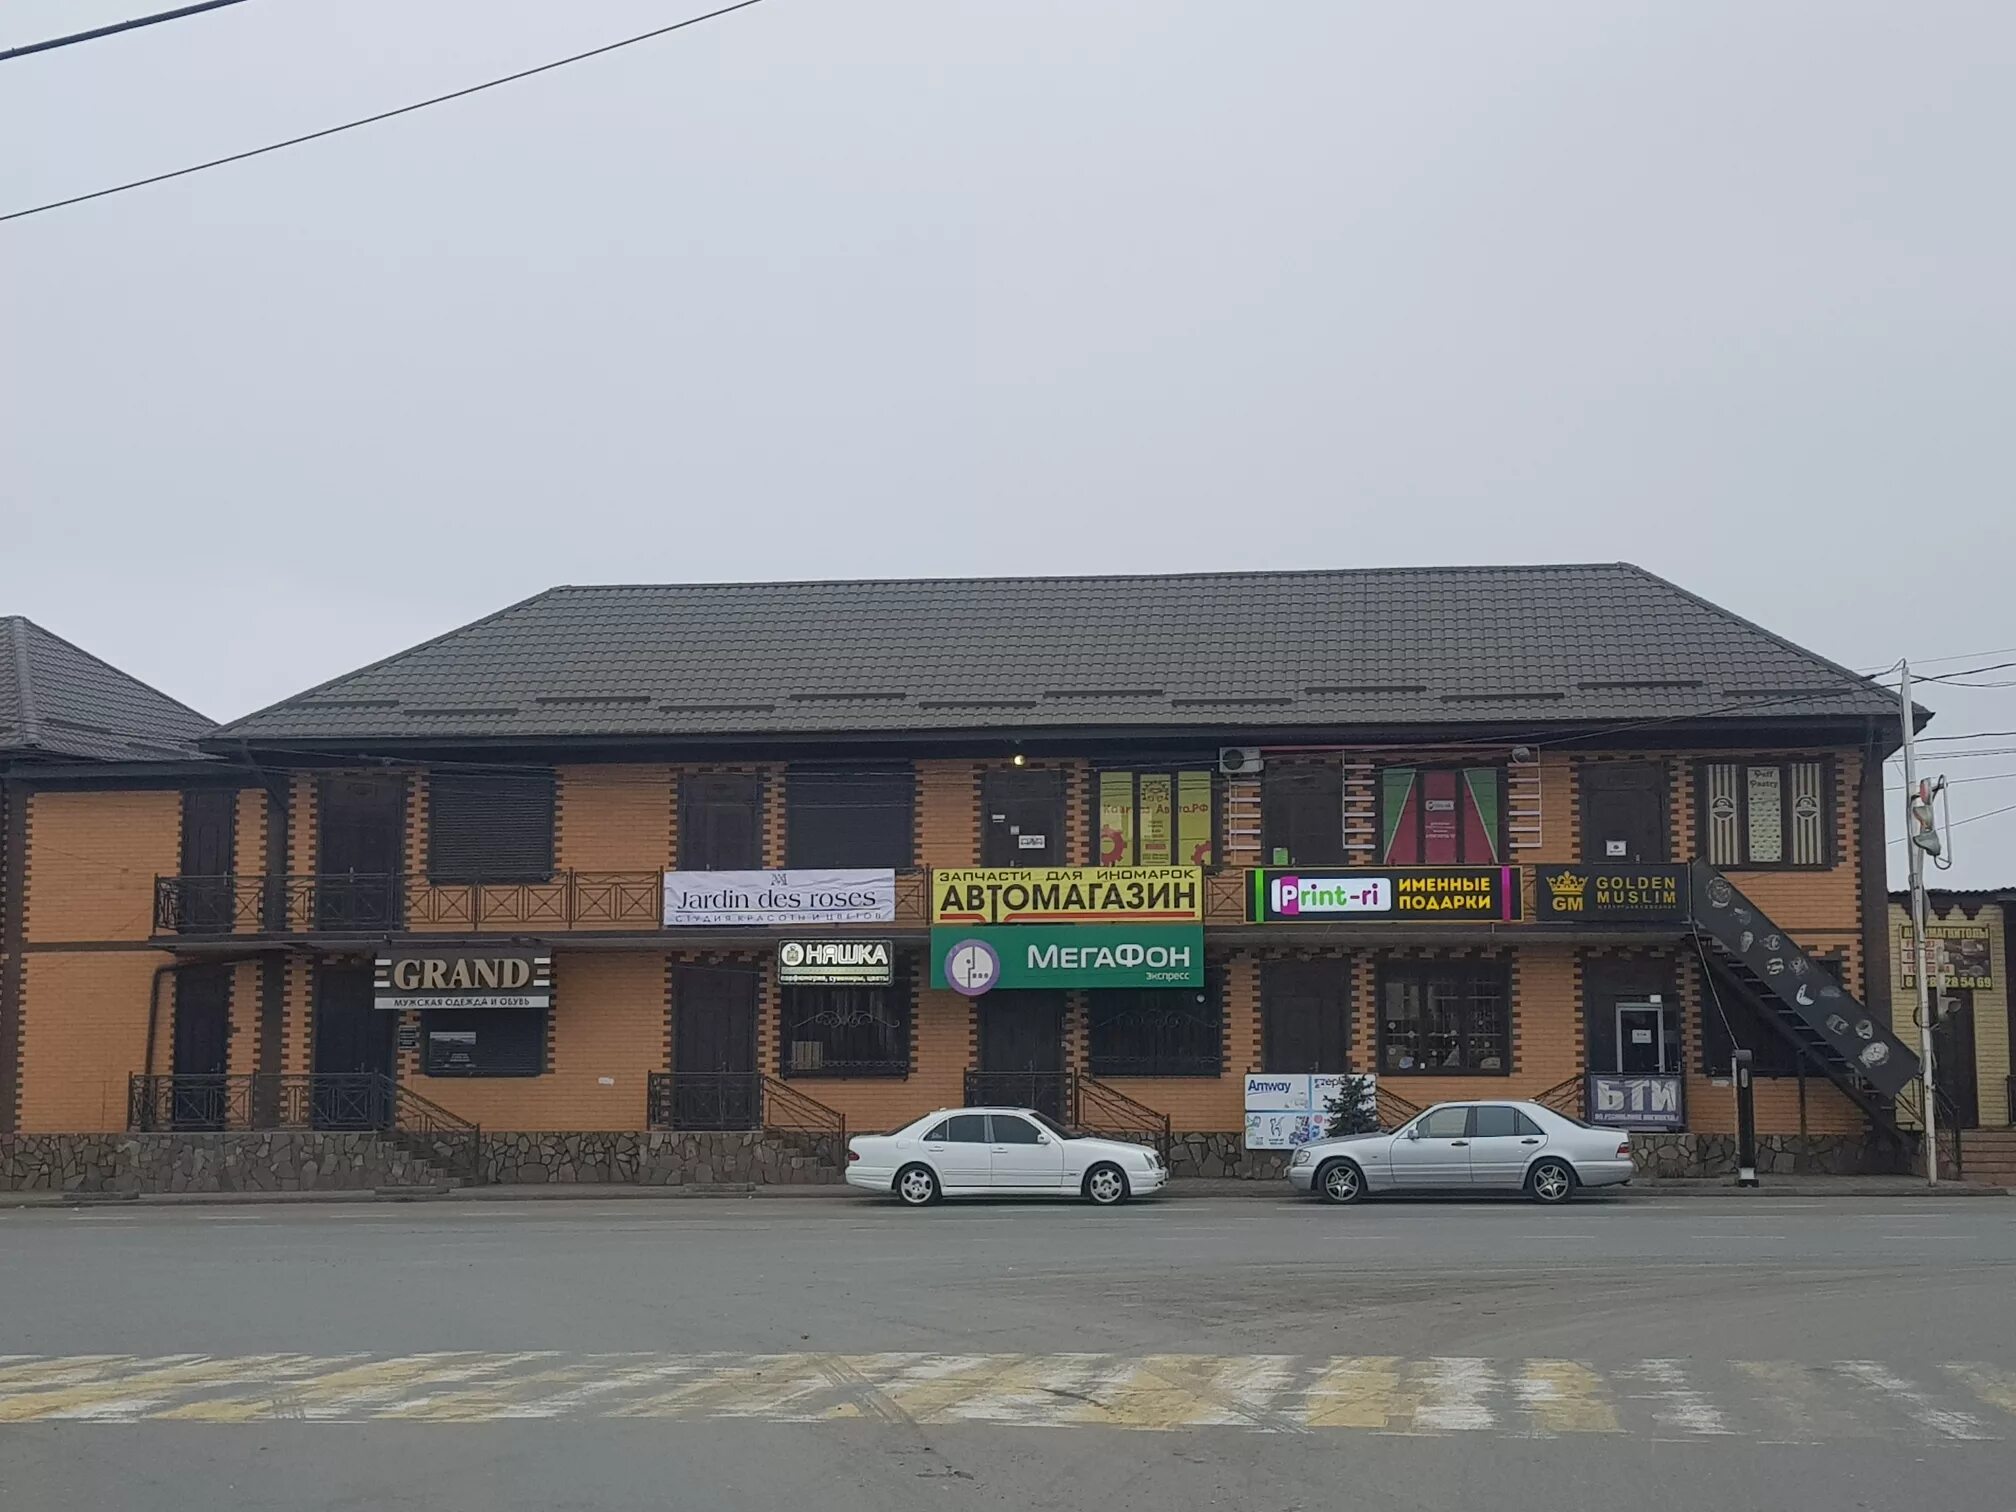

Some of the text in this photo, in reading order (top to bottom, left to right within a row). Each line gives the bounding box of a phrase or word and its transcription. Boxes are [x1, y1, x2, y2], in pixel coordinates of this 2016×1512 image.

[939, 869, 1194, 881] ЗАПЧАСТИ ДЛЯ ИНОМАРОК
[1596, 876, 1676, 889] GOLDEN
[1399, 877, 1490, 892] ИМЕННЫЕ
[677, 889, 876, 909] Jardin des roses
[940, 882, 1195, 922] АВТОМАГАЗИН
[1281, 883, 1378, 907] Print-ri
[1399, 895, 1490, 910] ПОДАРКИ
[1597, 891, 1676, 903] MUSLIM
[1552, 896, 1584, 911] GM
[675, 914, 731, 922] СТУДИЯ
[805, 944, 888, 965] НЯШКА
[393, 958, 530, 990] GRAND
[394, 997, 530, 1007] МУЖСКАЯ ОДЕЖДА И ОБУВЬ
[1248, 1079, 1292, 1093] Amway
[1597, 1079, 1677, 1111] БТИ
